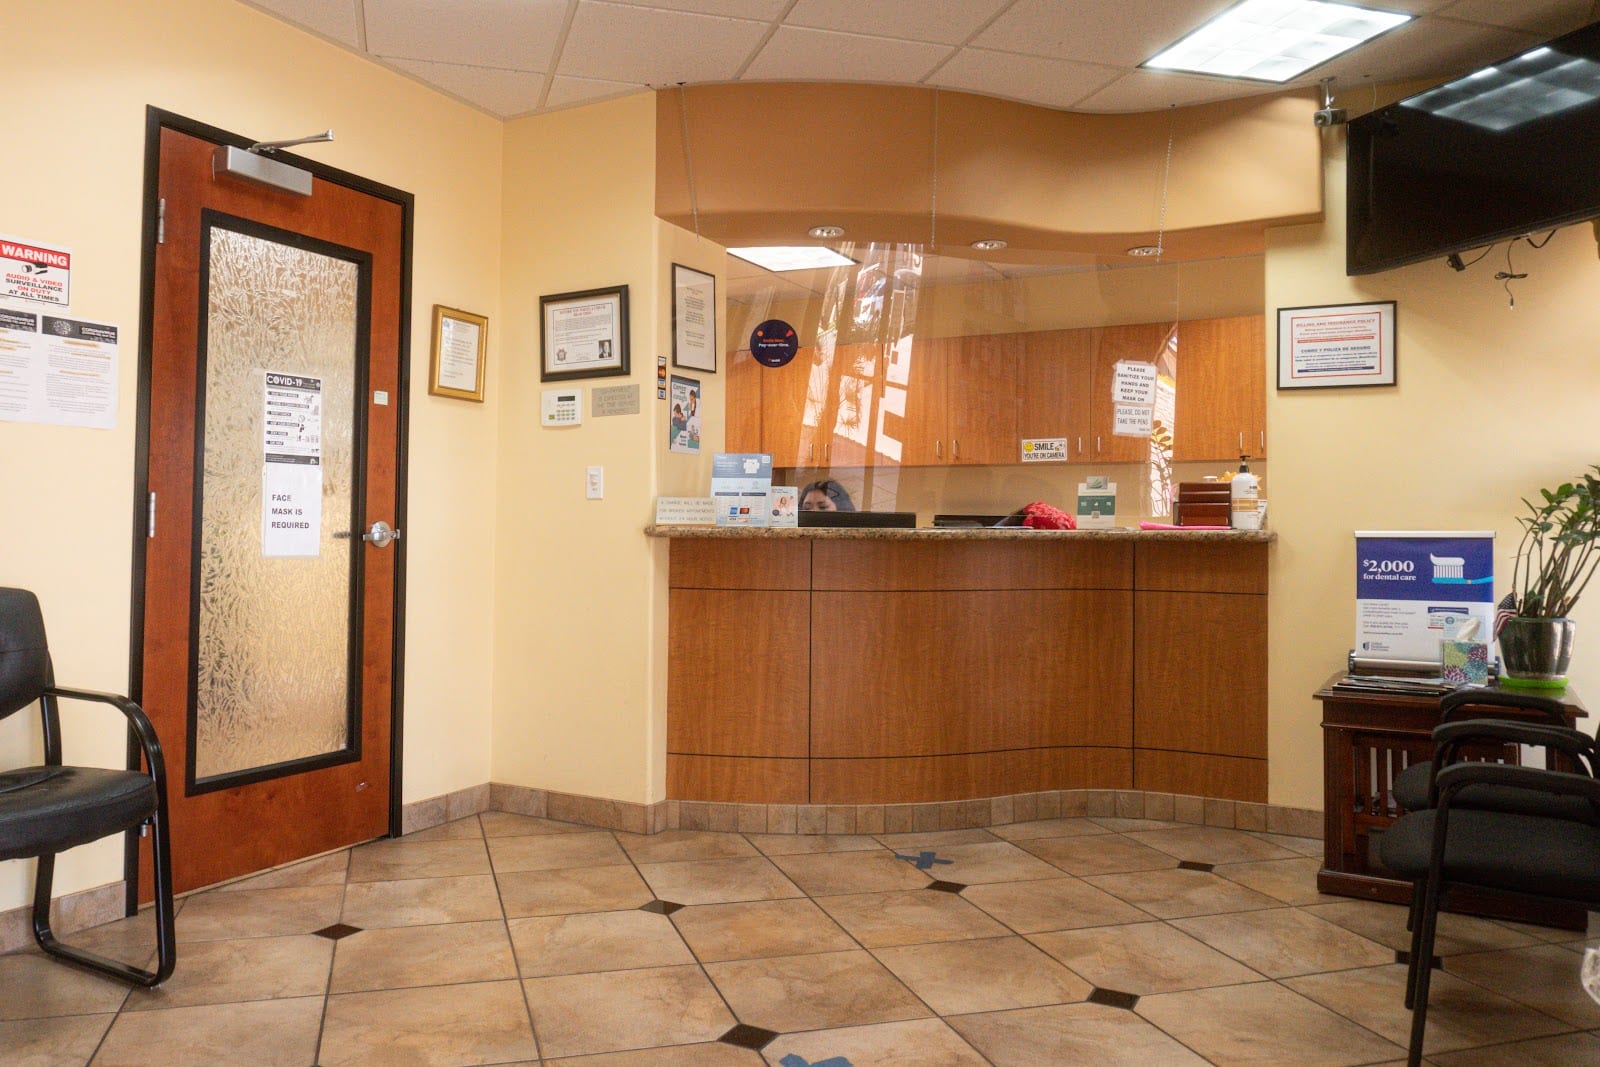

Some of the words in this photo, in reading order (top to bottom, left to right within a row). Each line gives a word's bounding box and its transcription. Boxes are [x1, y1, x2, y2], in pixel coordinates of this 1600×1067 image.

[2, 244, 68, 266] WARNING
[6, 273, 30, 282] AUDIO
[40, 279, 63, 287] VIDEO
[5, 278, 63, 292] SURVEILLANCE
[31, 287, 51, 295] DUTY
[37, 293, 60, 302] TIMES
[266, 375, 303, 386] COVID-19
[1034, 442, 1055, 450] SMILE
[271, 494, 292, 502] FACE
[295, 508, 303, 516] IS
[271, 521, 310, 529] REQUIRED
[1363, 558, 1415, 573] $2,000
[1363, 572, 1374, 580] for
[1375, 573, 1399, 581] dental
